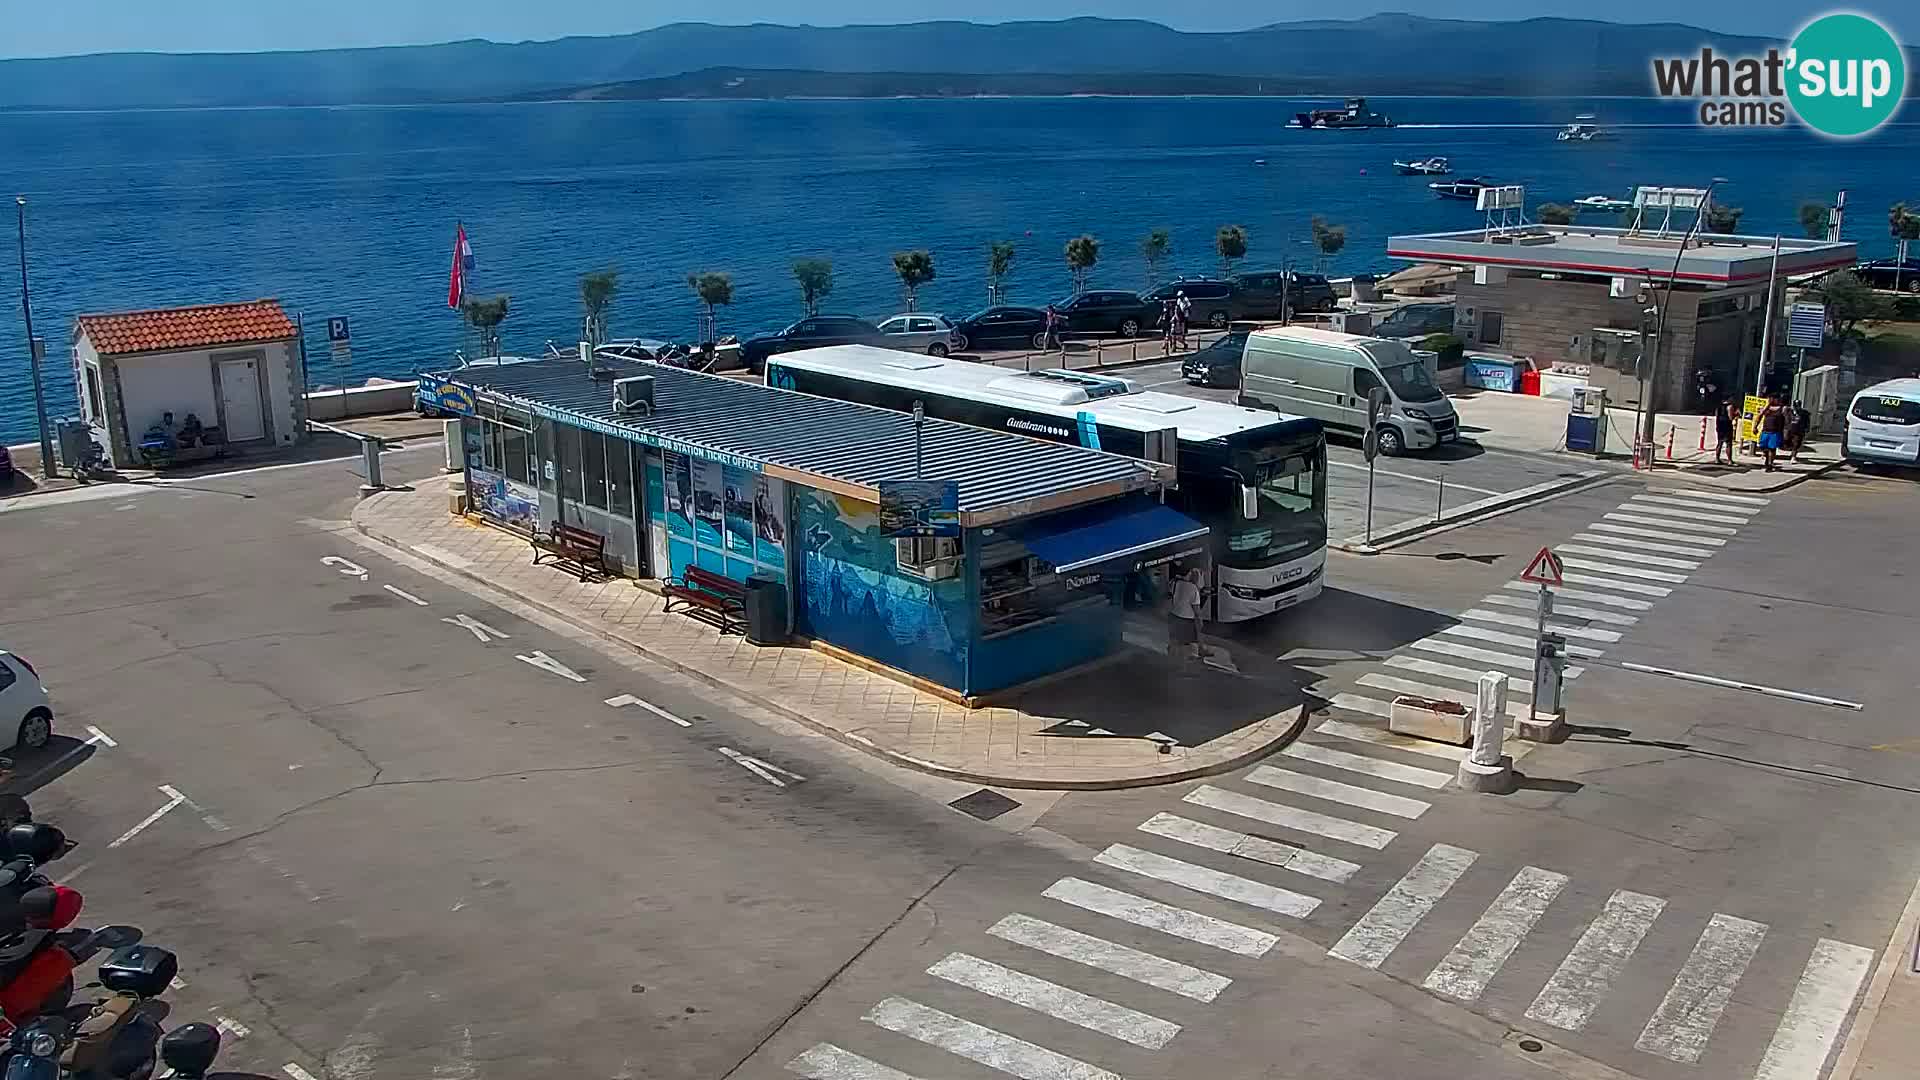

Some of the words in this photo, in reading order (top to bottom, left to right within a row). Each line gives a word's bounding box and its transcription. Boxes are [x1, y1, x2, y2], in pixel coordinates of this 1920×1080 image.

[1880, 398, 1900, 407] TAXI
[580, 418, 618, 437] AUTOBUSNA
[618, 428, 649, 445] POSTAJA
[658, 439, 673, 449] BUS
[673, 443, 705, 457] STATION
[706, 448, 732, 464] TICKET
[732, 456, 759, 471] OFFICE
[1272, 567, 1303, 583] IVECO
